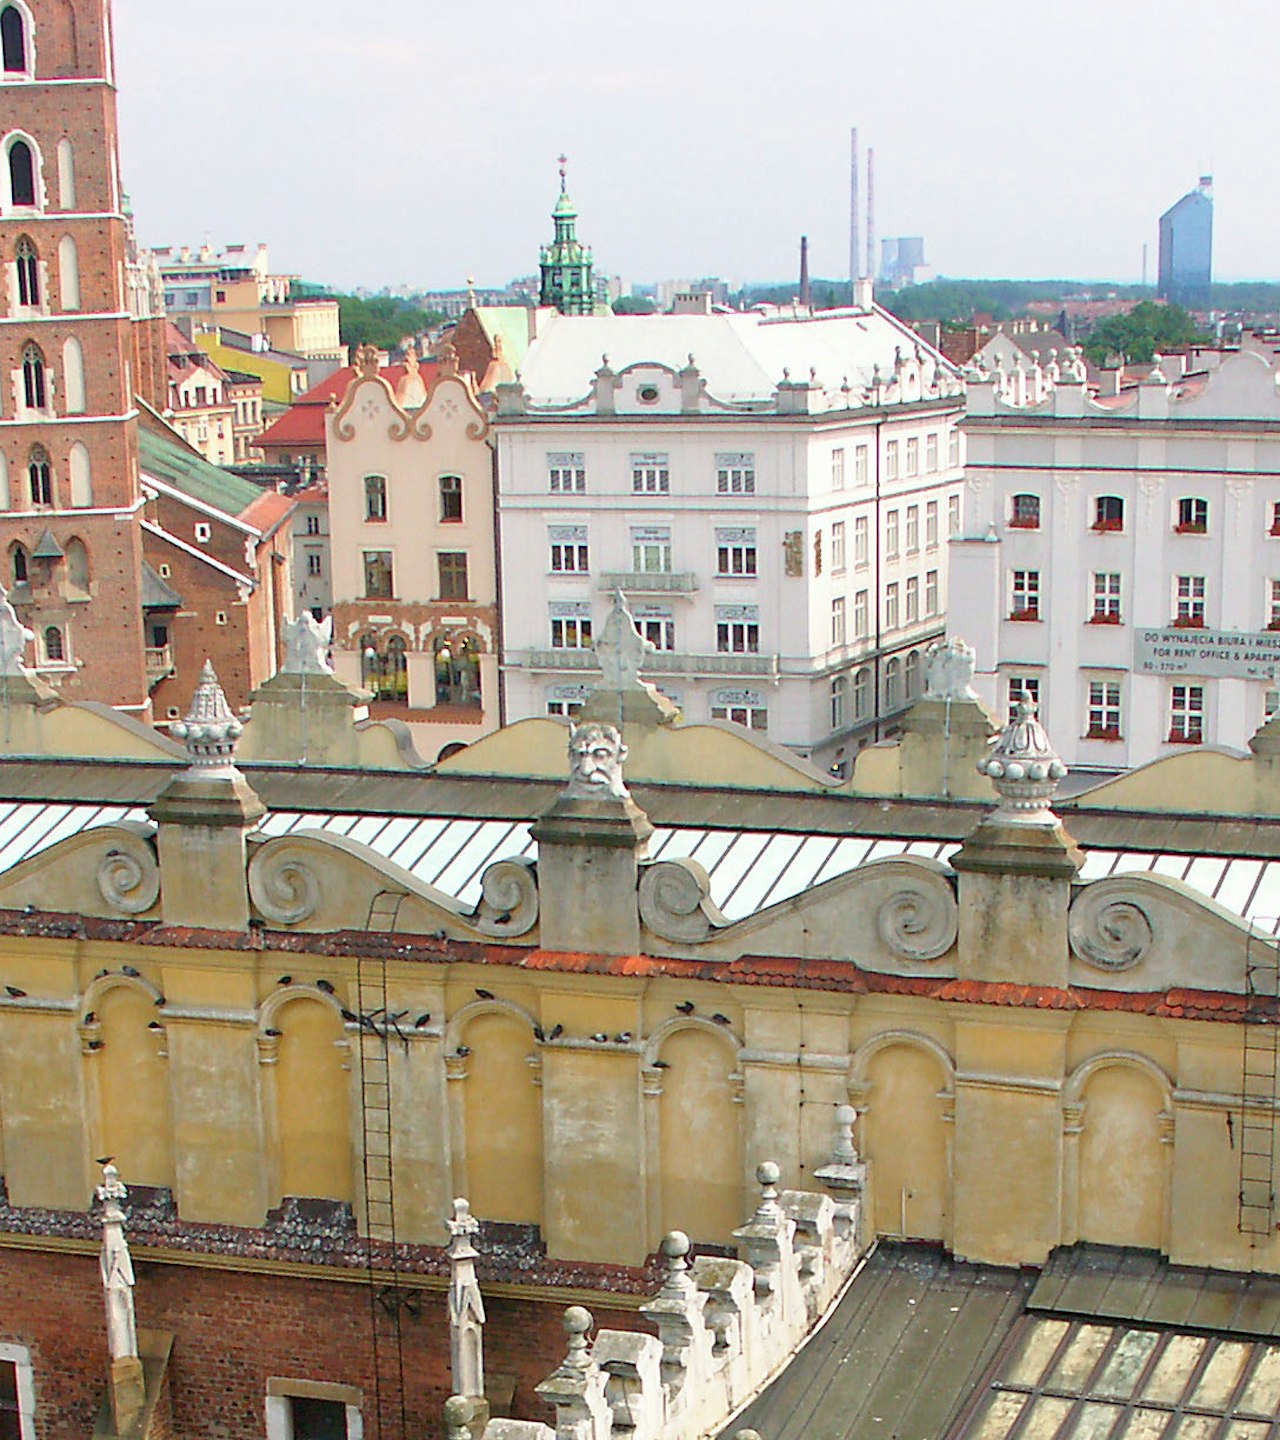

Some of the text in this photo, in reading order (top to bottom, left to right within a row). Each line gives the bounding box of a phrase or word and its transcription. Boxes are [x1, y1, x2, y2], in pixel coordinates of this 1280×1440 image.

[1144, 633, 1159, 642] DO
[1218, 635, 1245, 646] BIURA
[1153, 648, 1171, 657] FOR
[1174, 648, 1196, 658] RENT
[1200, 650, 1230, 660] OFFICE
